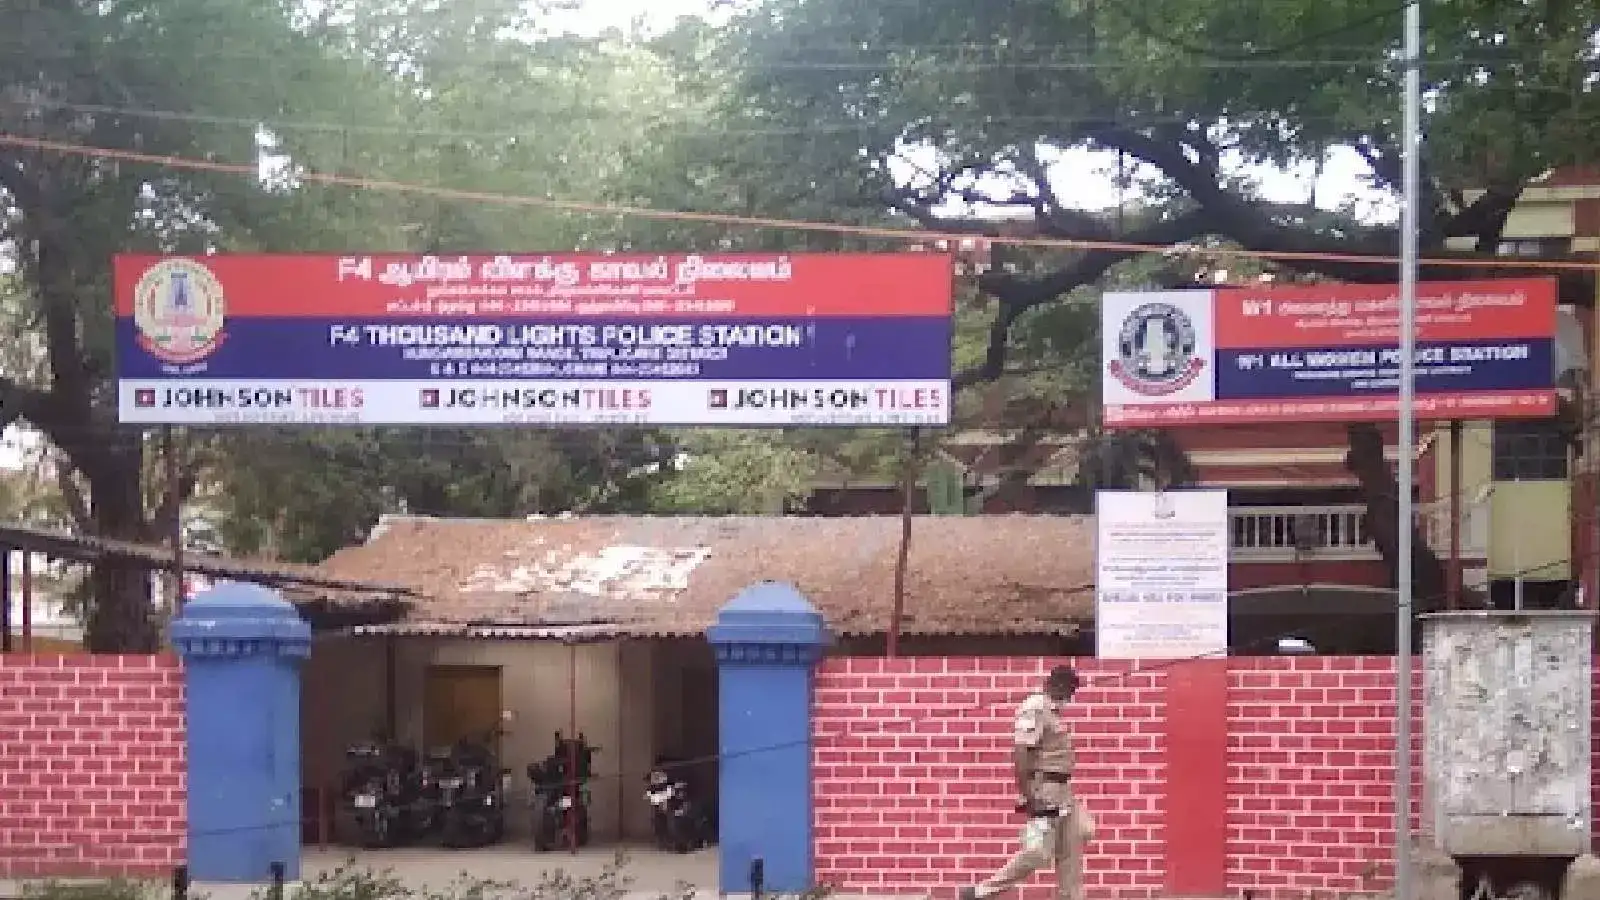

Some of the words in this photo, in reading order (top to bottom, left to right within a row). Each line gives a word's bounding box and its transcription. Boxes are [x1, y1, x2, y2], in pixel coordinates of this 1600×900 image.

[364, 325, 504, 345] THOUSAND
[506, 325, 596, 346] LIGHTS
[602, 325, 692, 346] POLICE
[698, 325, 801, 346] STATION
[1378, 347, 1444, 364] POICE
[163, 388, 292, 409] JOHNSON
[297, 388, 364, 409] TILES
[446, 388, 580, 409] JOHNSON
[582, 388, 652, 409] TILES
[734, 388, 868, 409] JOHNSON
[874, 388, 941, 409] TILES
